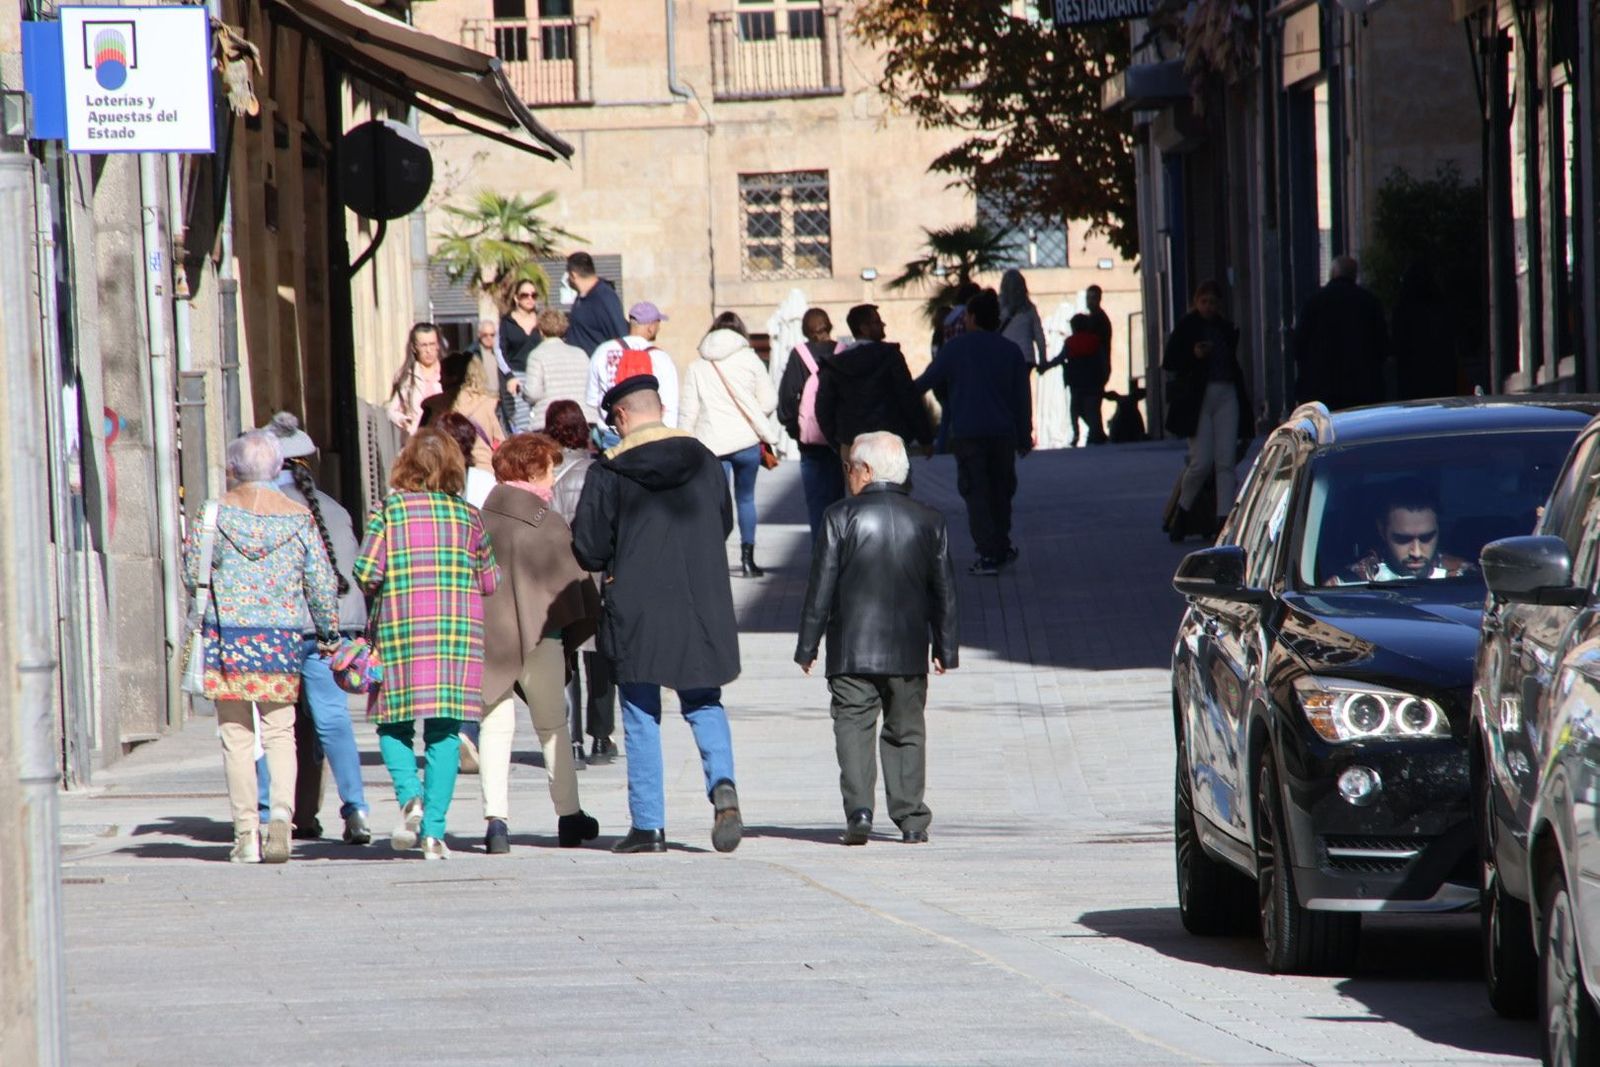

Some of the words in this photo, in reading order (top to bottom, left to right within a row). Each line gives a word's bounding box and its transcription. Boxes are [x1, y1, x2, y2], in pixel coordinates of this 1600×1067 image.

[148, 97, 155, 109] y
[88, 111, 152, 125] Apuestas
[157, 110, 177, 122] del
[88, 126, 135, 139] Estado
